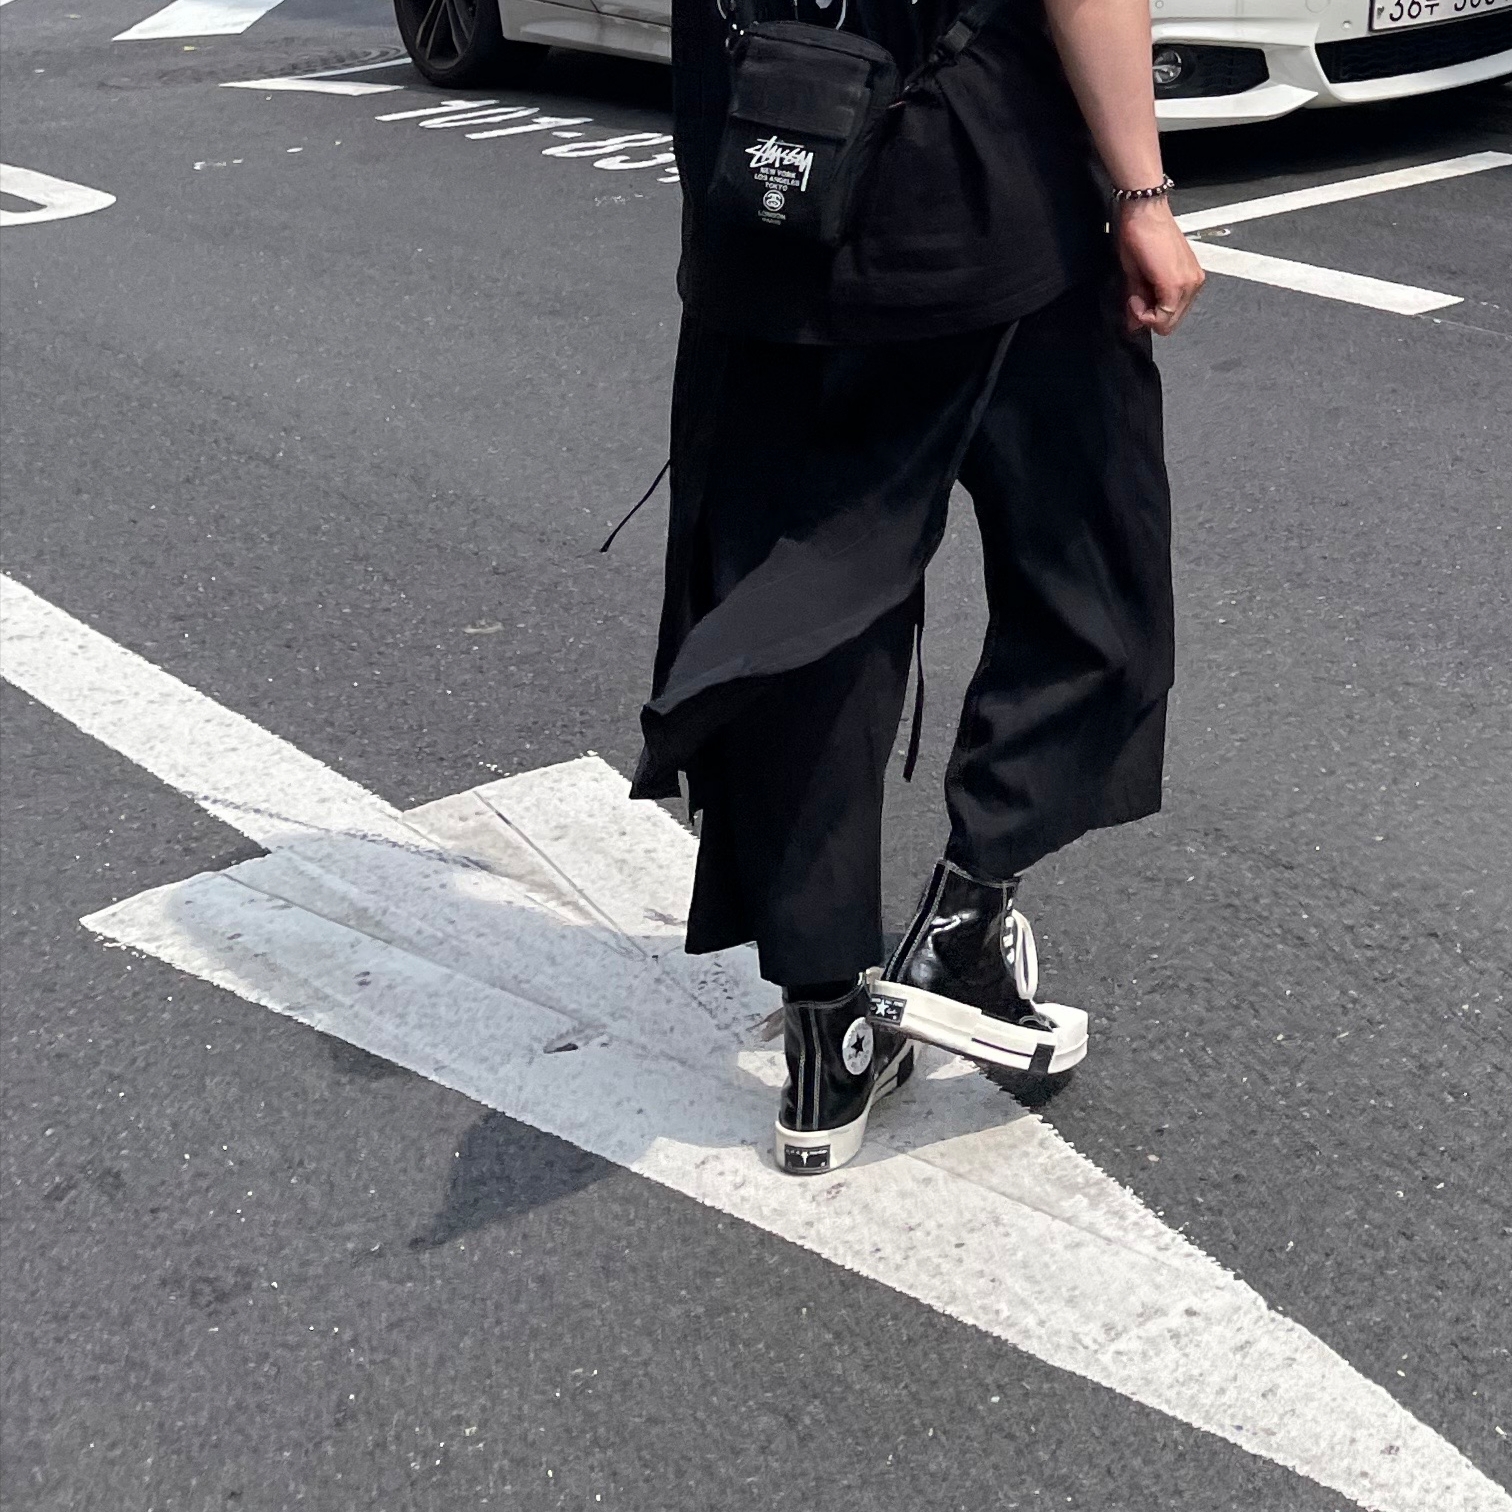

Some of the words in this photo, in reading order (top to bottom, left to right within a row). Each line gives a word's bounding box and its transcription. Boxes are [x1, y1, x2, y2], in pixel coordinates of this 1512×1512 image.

[760, 167, 776, 176] NEW
[777, 169, 797, 179] YORK
[754, 173, 768, 181] LOS
[769, 175, 800, 187] ANGELES
[765, 181, 788, 192] TOKYO
